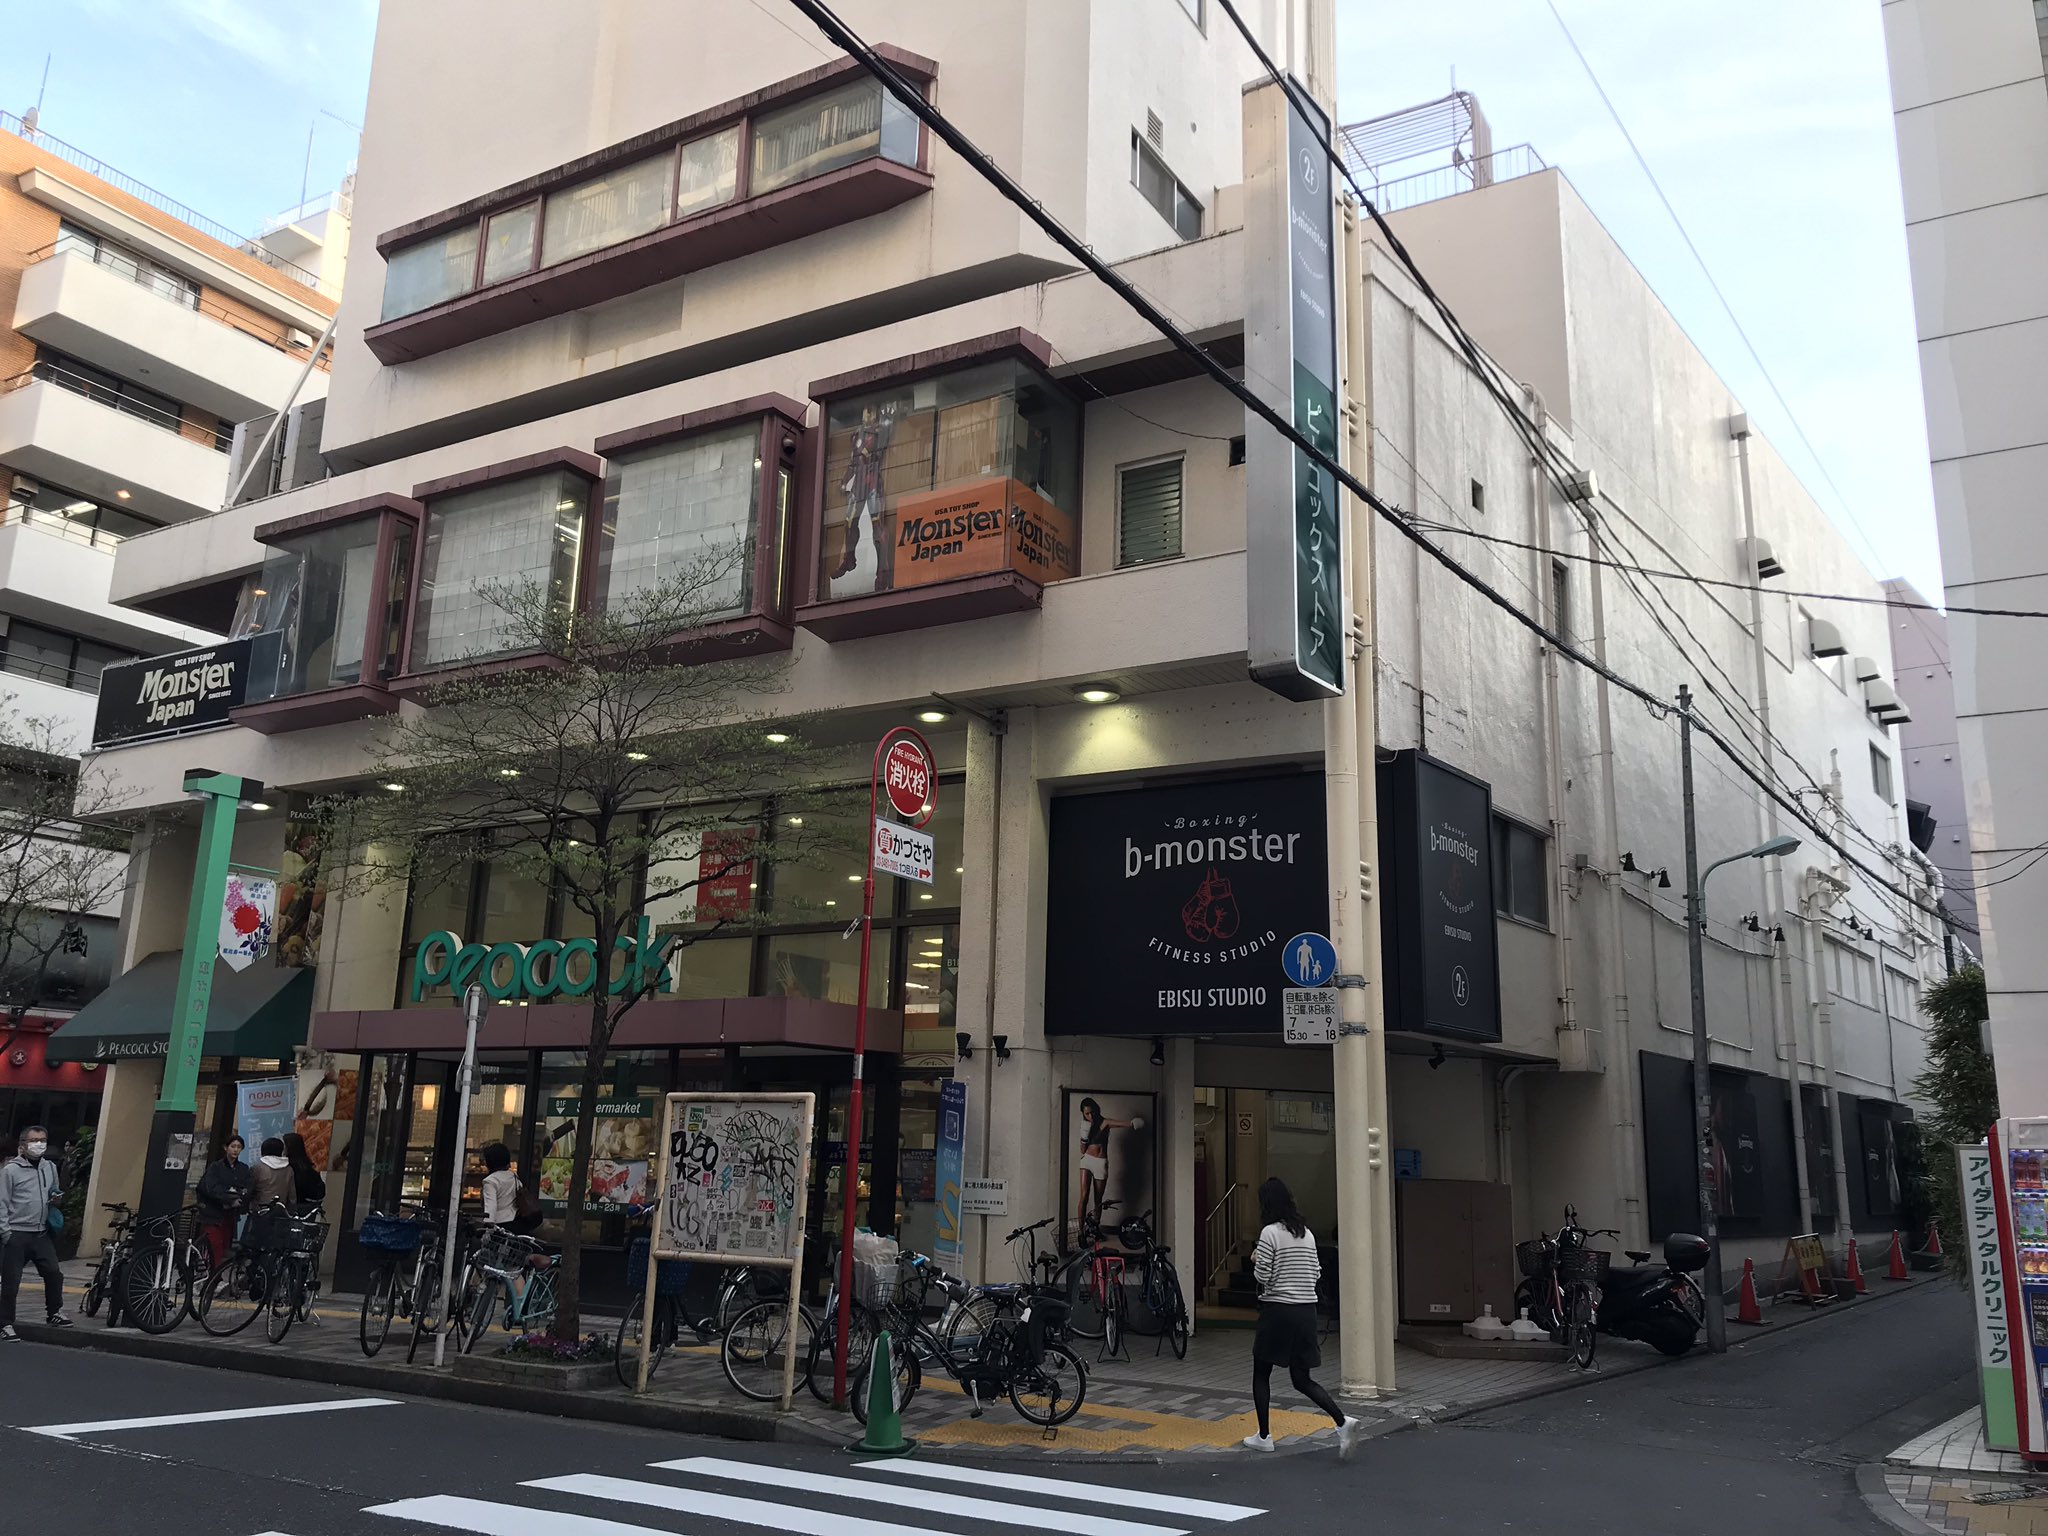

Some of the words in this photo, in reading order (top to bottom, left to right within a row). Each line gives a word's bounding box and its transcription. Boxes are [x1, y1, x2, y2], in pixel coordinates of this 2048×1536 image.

[1304, 156, 1316, 187] 2F
[1291, 205, 1328, 255] b-monster
[934, 507, 948, 516] USA
[949, 505, 961, 513] TOY
[962, 501, 980, 510] SHOP
[897, 508, 1004, 547] Monster
[1008, 504, 1073, 566] Monster
[911, 540, 963, 563] Japan
[1016, 536, 1049, 569] Japan
[174, 658, 186, 667] USA
[187, 656, 198, 665] TOY
[198, 652, 216, 662] SHOP
[136, 662, 235, 705] Monster
[146, 699, 194, 725] Japan
[894, 747, 904, 758] FIRE
[904, 751, 924, 766] HYDRANT
[889, 758, 926, 798] 消火栓
[290, 810, 320, 819] PEACOC
[1174, 814, 1247, 829] Boxing
[893, 834, 932, 865] かづさや
[1125, 828, 1301, 878] b-monster
[1430, 825, 1479, 866] b-monster
[1444, 925, 1457, 938] EBISU
[1457, 928, 1472, 942] STUDIO
[1148, 937, 1211, 964] FITNESS
[1220, 930, 1277, 963] STUDIO
[1158, 989, 1201, 1008] EBISU
[1208, 987, 1267, 1007] STUDIO
[1286, 992, 1335, 1003] 自転車を除く
[1455, 972, 1465, 999] 2F
[1290, 1017, 1297, 1028] 7
[1325, 1016, 1333, 1028] 9
[1326, 1029, 1336, 1041] 18
[109, 1042, 150, 1055] PEACOCK
[555, 1100, 566, 1108] B1F
[577, 1101, 641, 1114] ermarket
[1969, 1157, 2009, 1364] アイダデンタルクリニック
